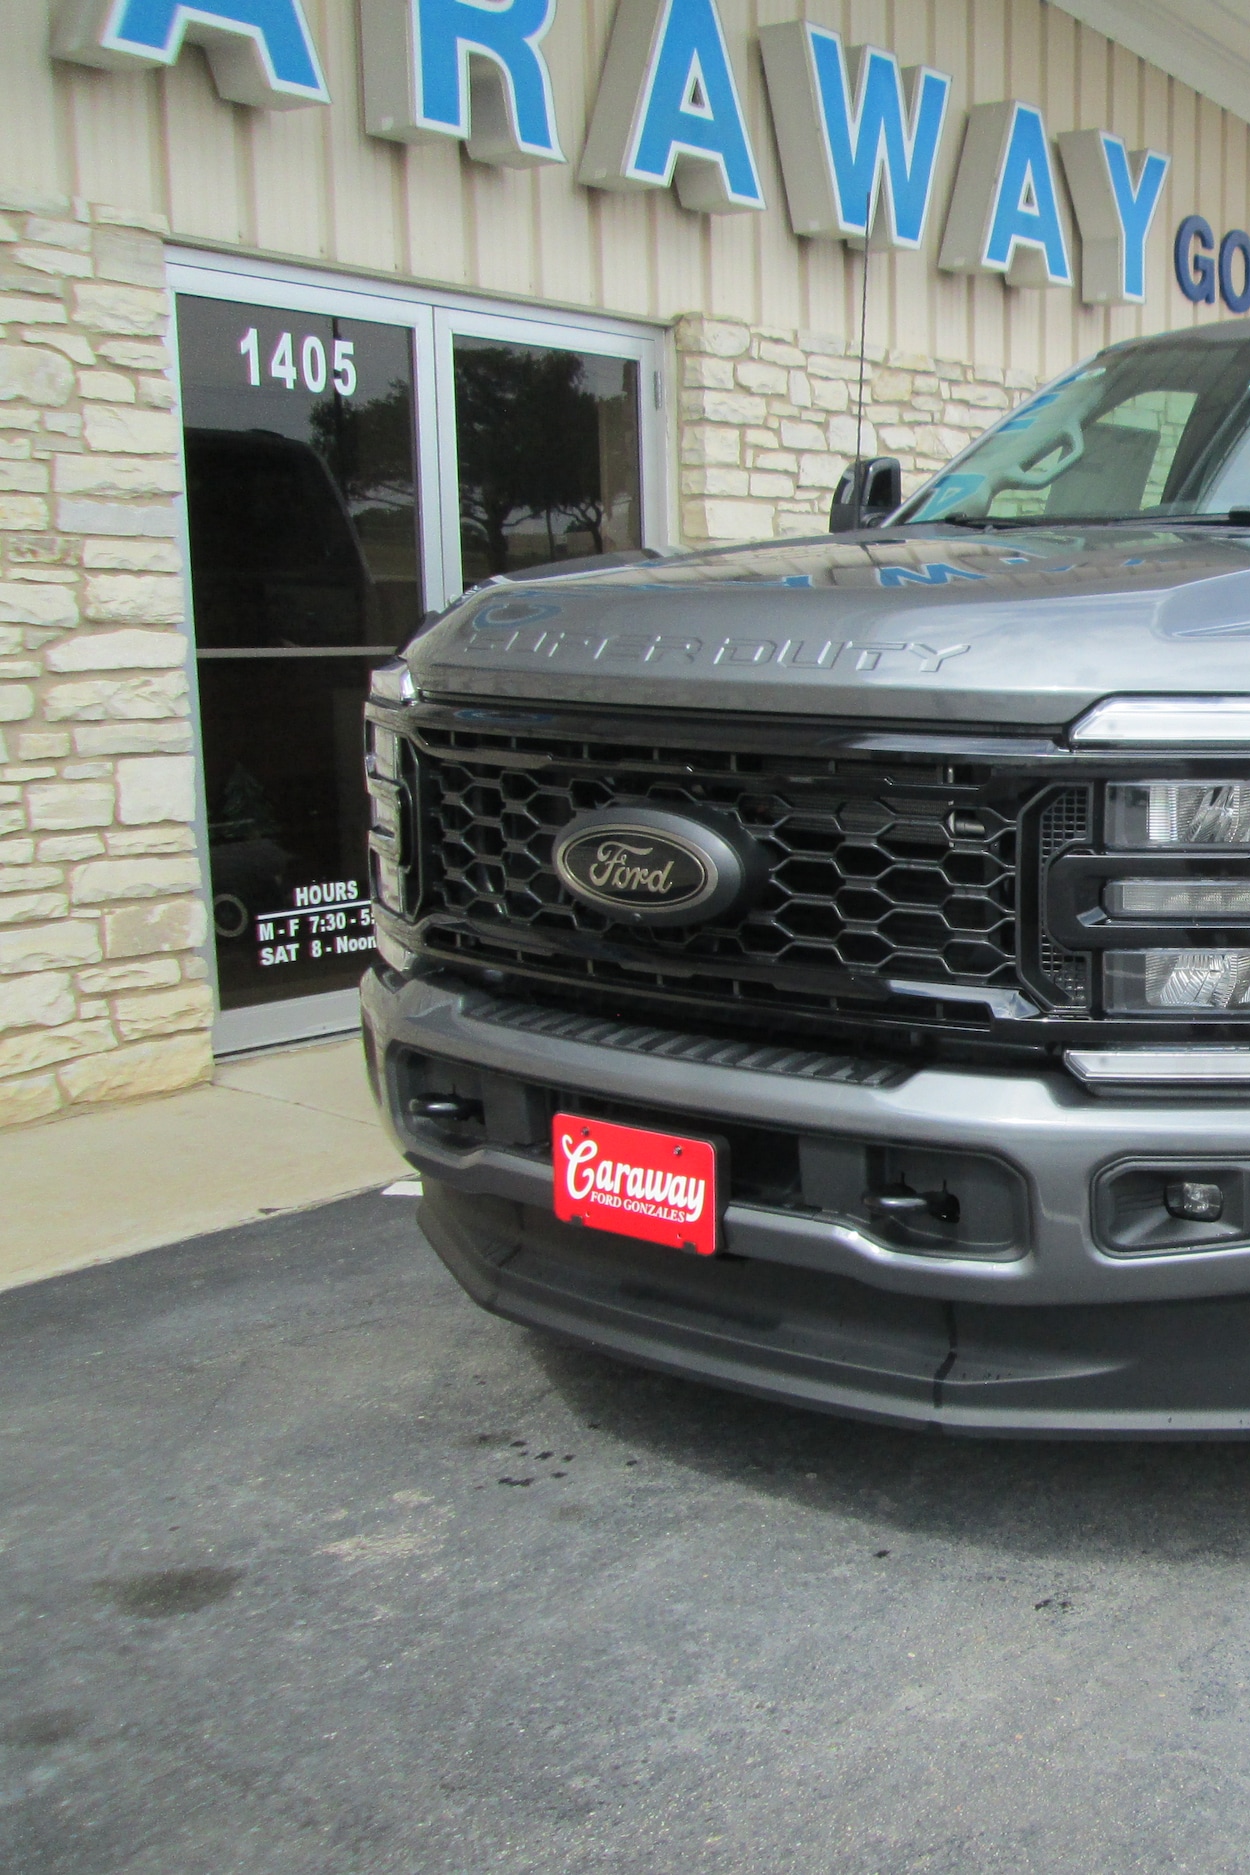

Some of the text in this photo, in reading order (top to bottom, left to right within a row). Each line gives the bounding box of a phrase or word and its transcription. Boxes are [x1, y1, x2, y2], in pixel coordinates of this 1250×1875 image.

[240, 328, 358, 396] 1405
[589, 841, 675, 894] Ford
[295, 880, 359, 906] HOURS
[259, 923, 274, 942] M
[290, 918, 300, 937] F
[309, 911, 346, 934] 7:30
[260, 943, 299, 966] SAT
[311, 940, 322, 958] 8
[336, 935, 377, 954] Noon
[562, 1134, 705, 1223] Caraway
[590, 1191, 687, 1223] FORD GONZALES
